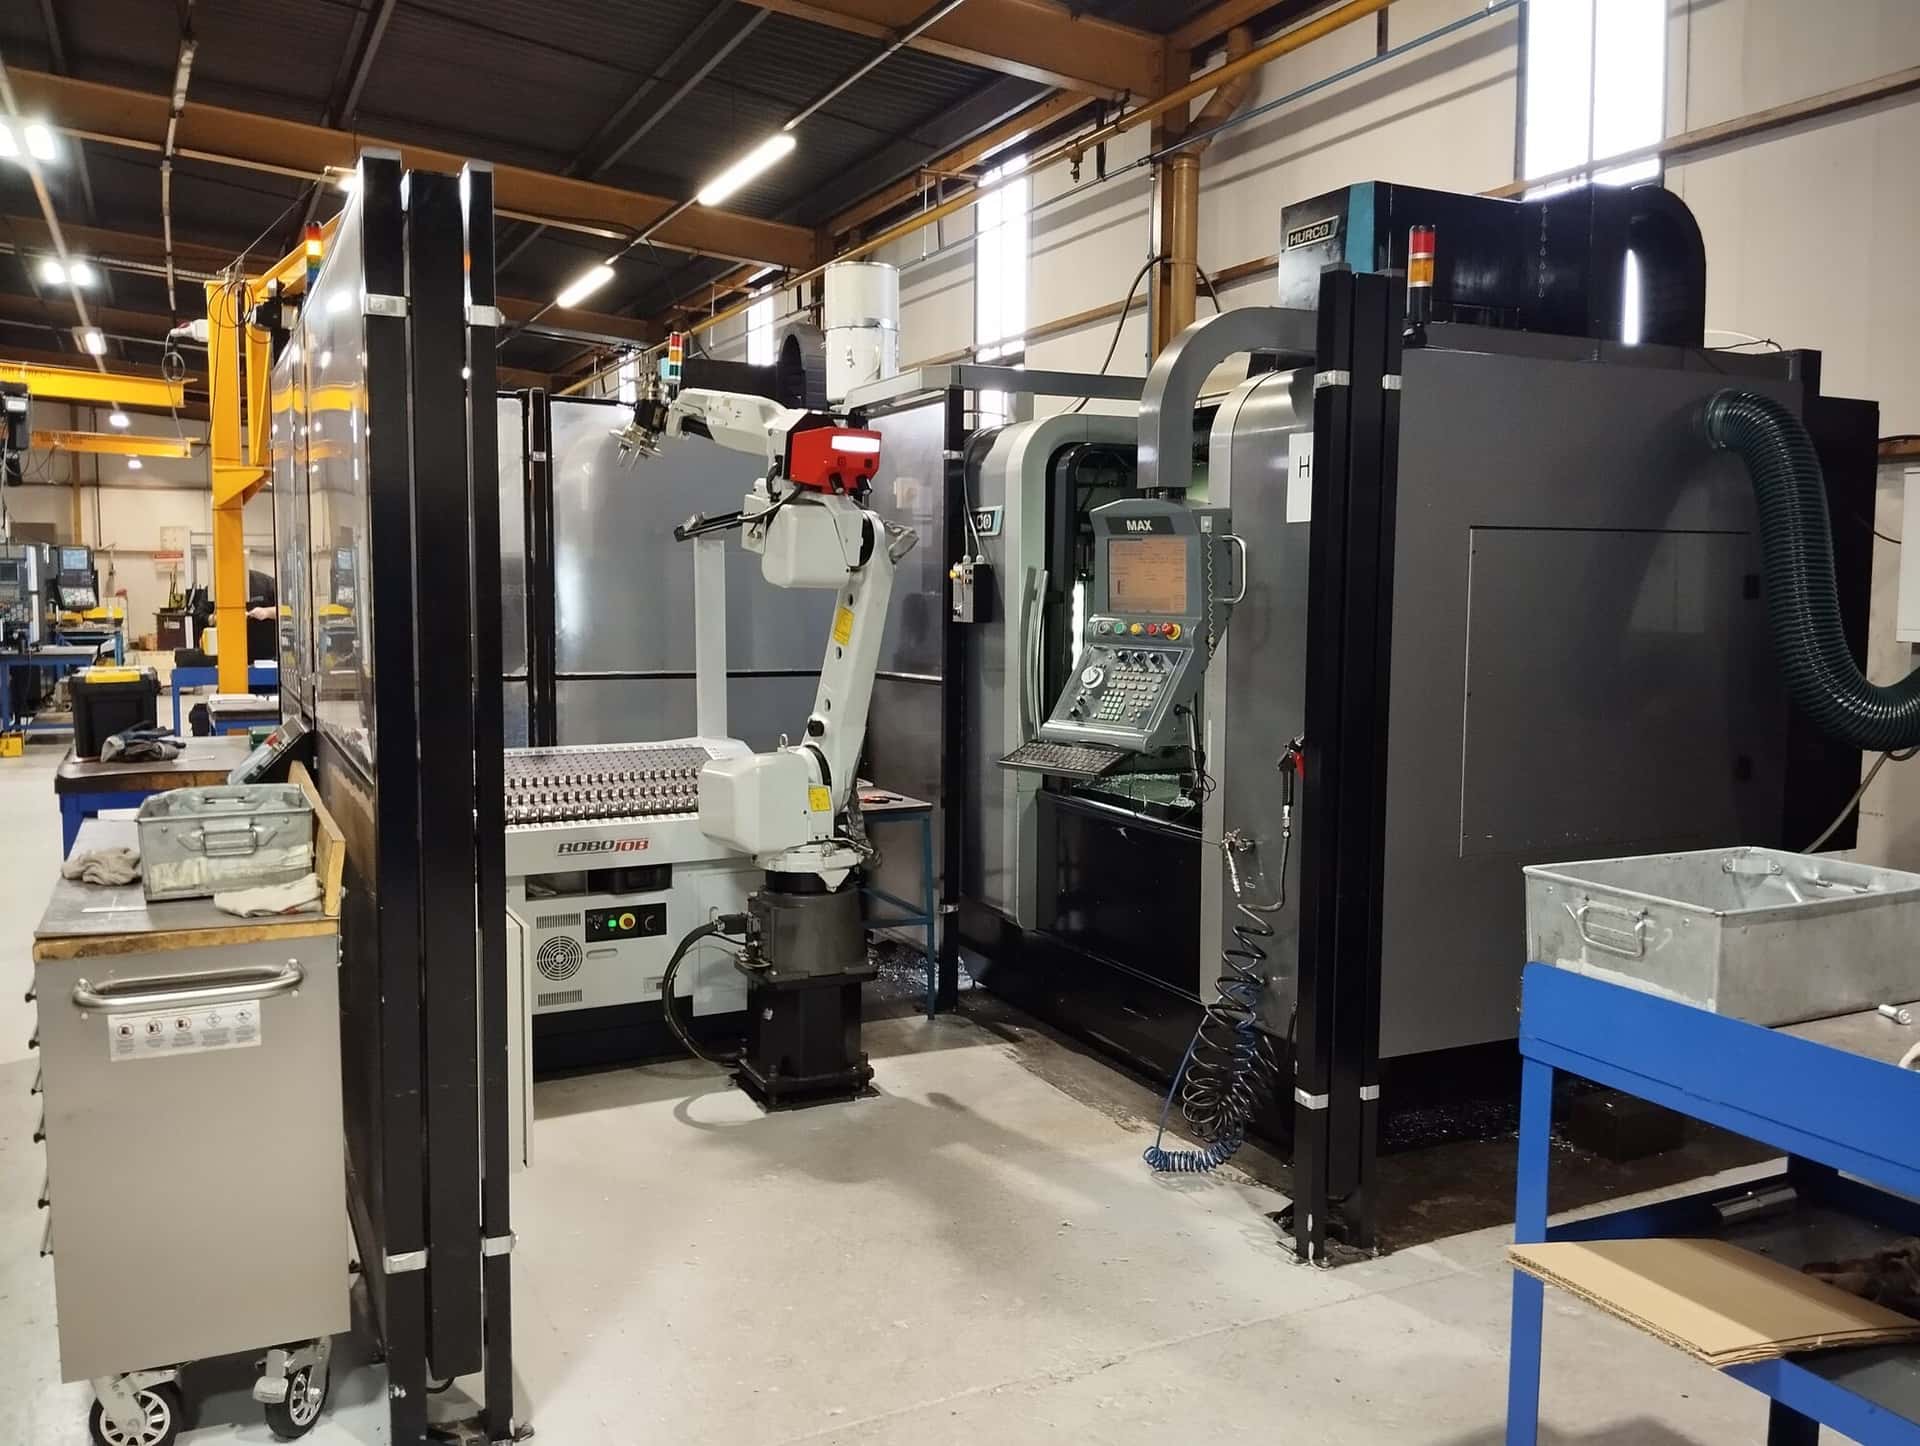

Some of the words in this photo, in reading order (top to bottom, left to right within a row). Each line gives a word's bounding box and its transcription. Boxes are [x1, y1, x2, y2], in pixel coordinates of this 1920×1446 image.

[1290, 224, 1329, 245] HURCO
[1299, 455, 1310, 479] H
[1126, 519, 1153, 531] MAX
